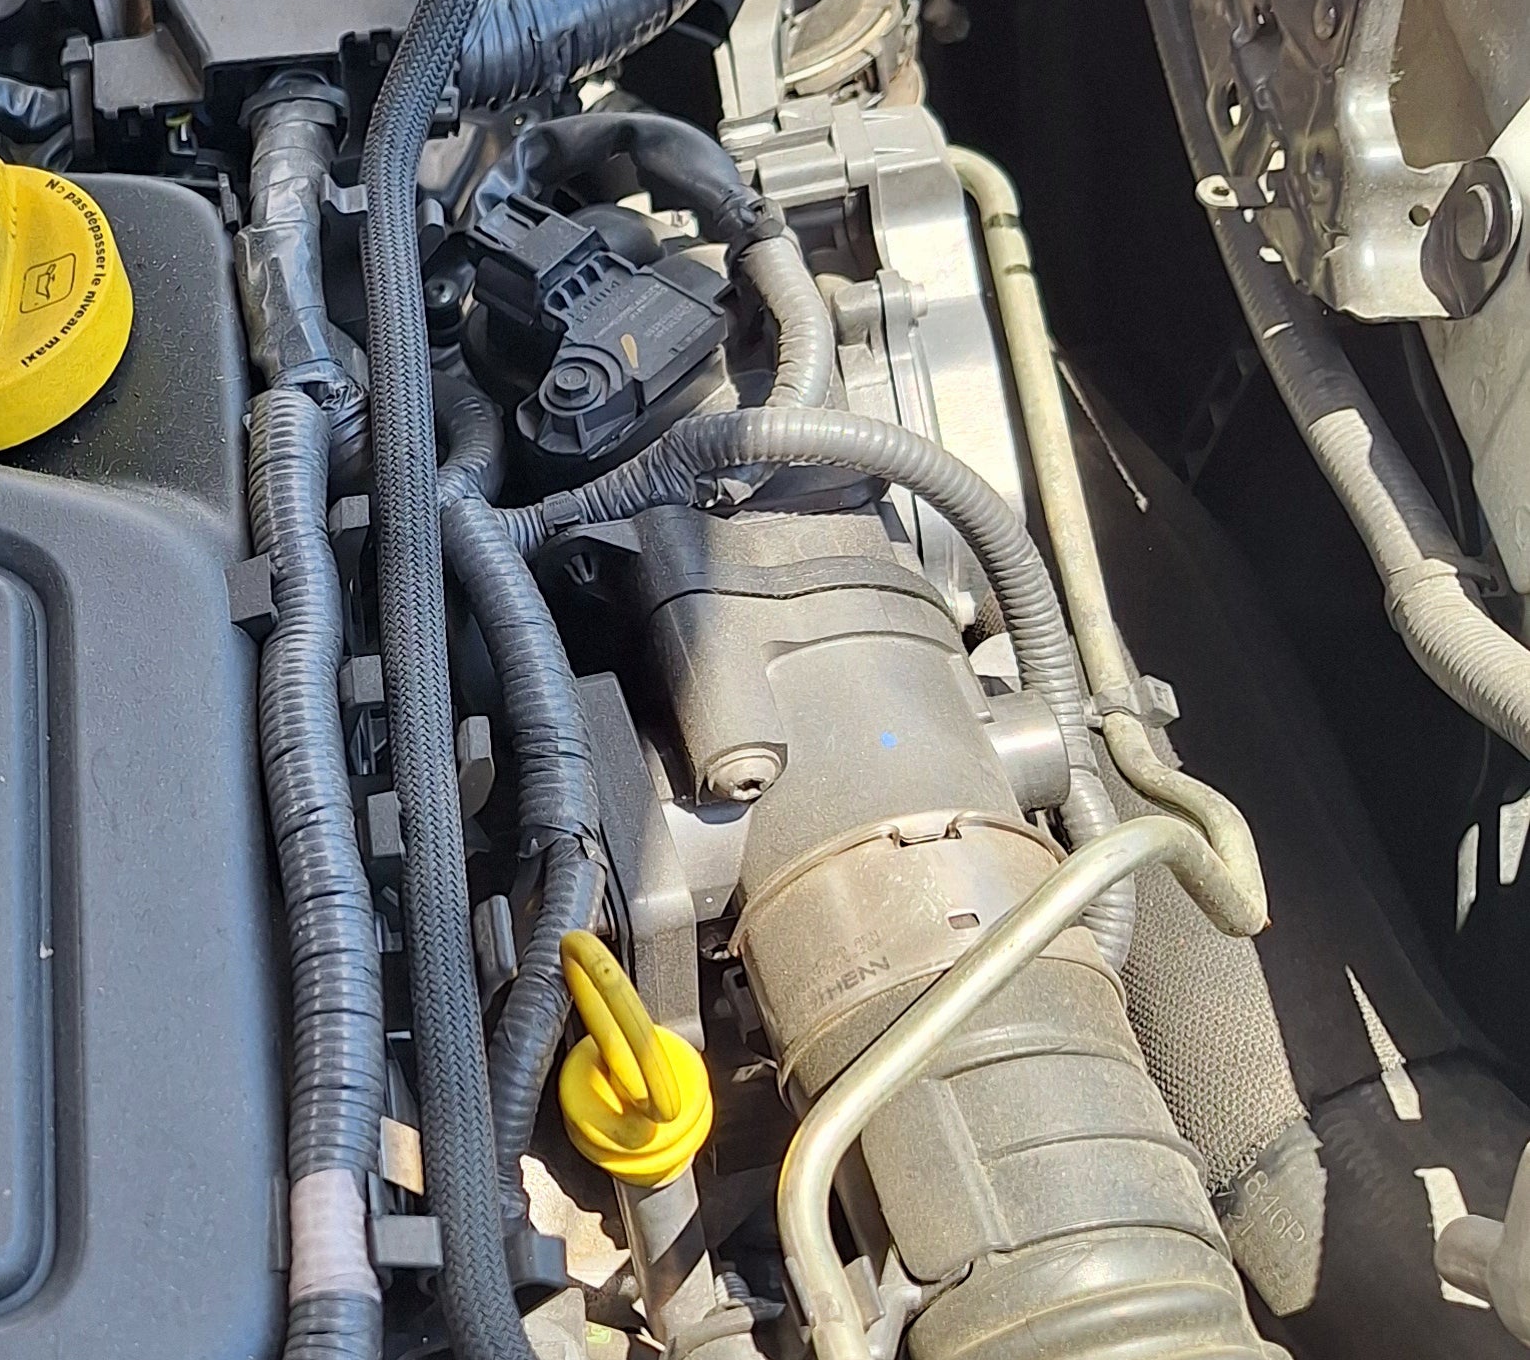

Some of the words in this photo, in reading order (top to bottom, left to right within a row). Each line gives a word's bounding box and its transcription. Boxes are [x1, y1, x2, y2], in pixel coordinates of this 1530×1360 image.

[63, 191, 88, 212] pas
[83, 209, 106, 271] dépasser
[91, 273, 107, 287] le
[60, 290, 97, 335] niveau
[20, 335, 61, 368] maxi
